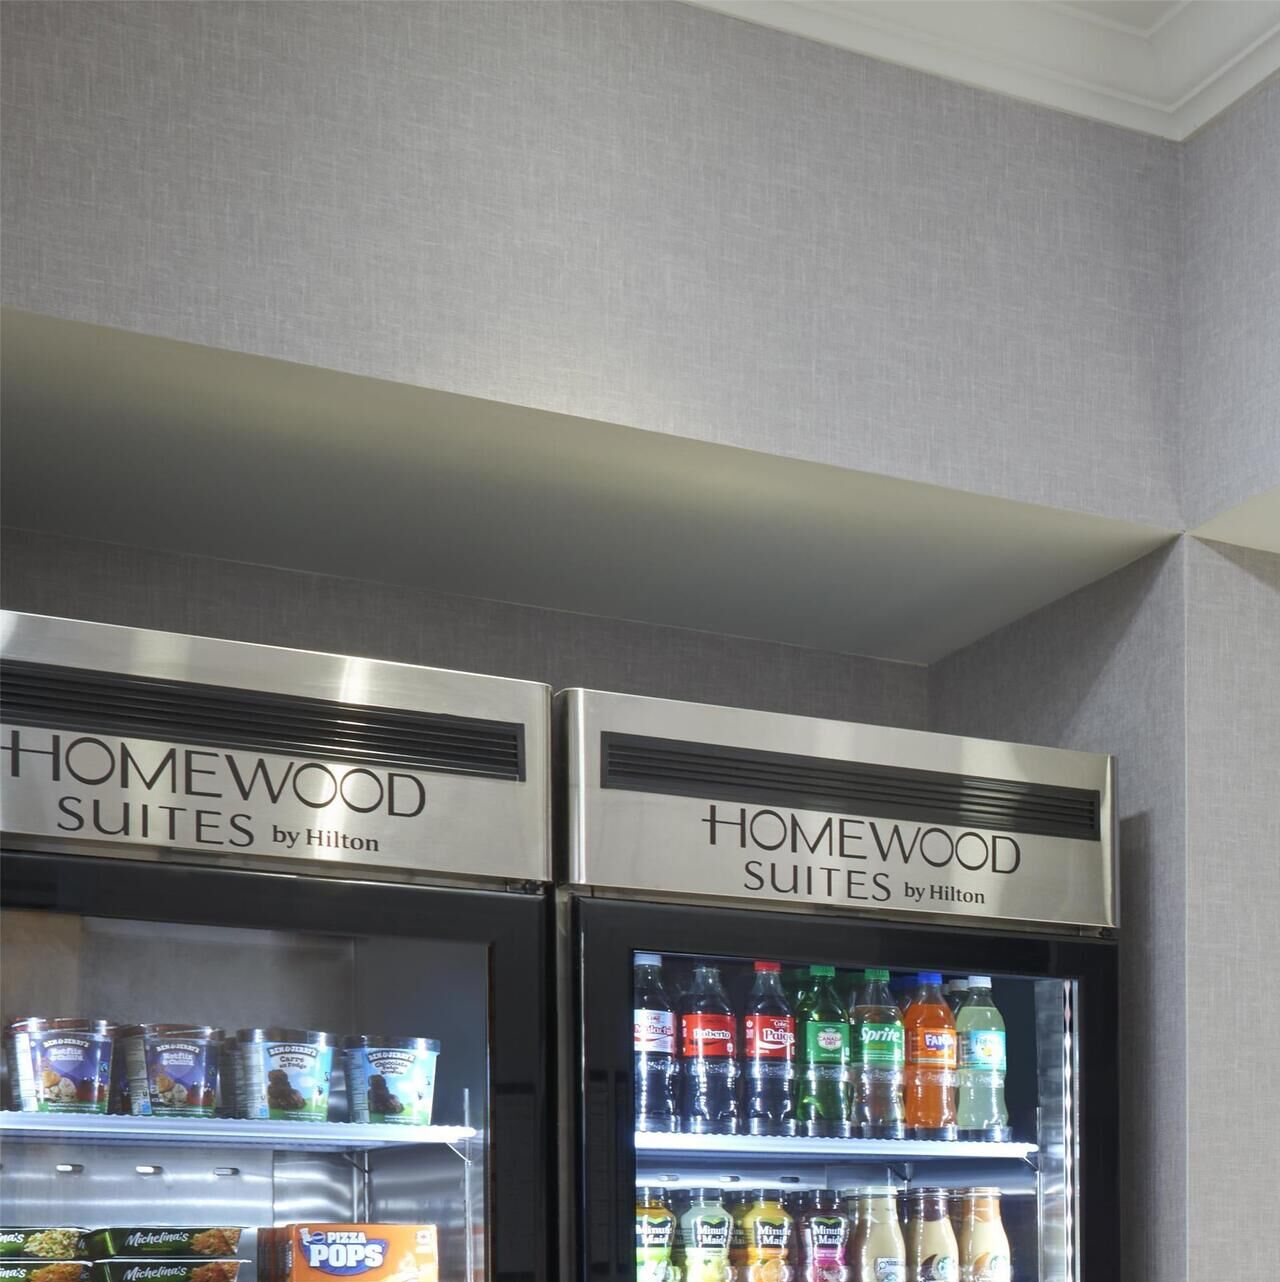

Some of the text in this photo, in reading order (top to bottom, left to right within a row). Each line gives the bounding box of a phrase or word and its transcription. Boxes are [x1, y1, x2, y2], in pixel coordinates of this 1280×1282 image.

[0, 729, 427, 819] HOMEWOOD
[56, 795, 380, 855] SUITES by Hilton
[701, 803, 1022, 875] HOMEWOOD
[743, 859, 986, 905] SUITES by Hilton
[763, 1028, 794, 1043] Paige
[860, 1027, 901, 1044] Sprite
[125, 1231, 190, 1249] Michelina's
[327, 1232, 367, 1243] PIZZA
[309, 1244, 385, 1268] POPS
[123, 1265, 188, 1282] Michelina's
